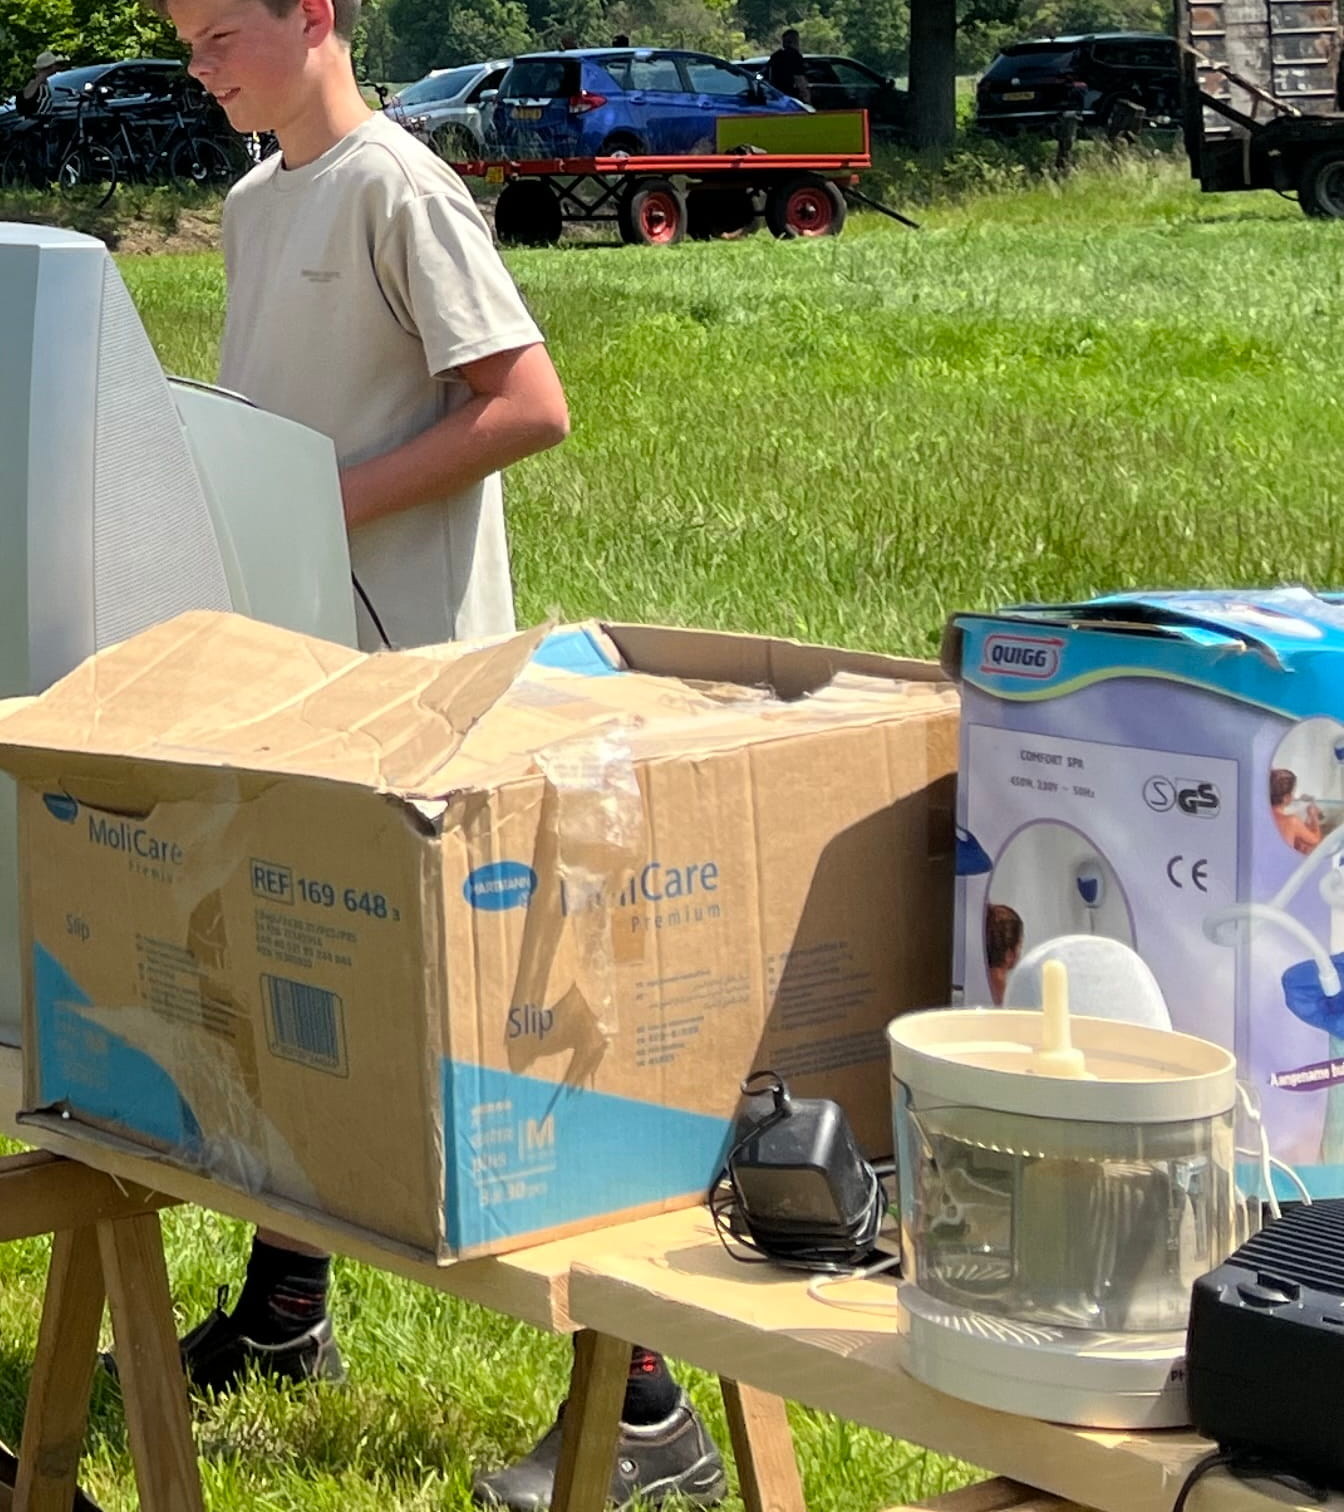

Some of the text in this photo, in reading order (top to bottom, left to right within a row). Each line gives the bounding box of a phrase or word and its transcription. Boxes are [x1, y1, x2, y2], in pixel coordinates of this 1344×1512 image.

[991, 643, 1048, 668] QUIGG
[1019, 749, 1063, 767] COMFORT
[88, 814, 184, 866] MoliCare
[128, 859, 175, 885] Premiu
[1167, 854, 1209, 892] CE
[254, 866, 289, 896] REF
[297, 877, 335, 907] 169
[344, 888, 388, 919] 648
[66, 913, 91, 943] Slip
[630, 903, 721, 934] Premium
[507, 1004, 554, 1041] Slip
